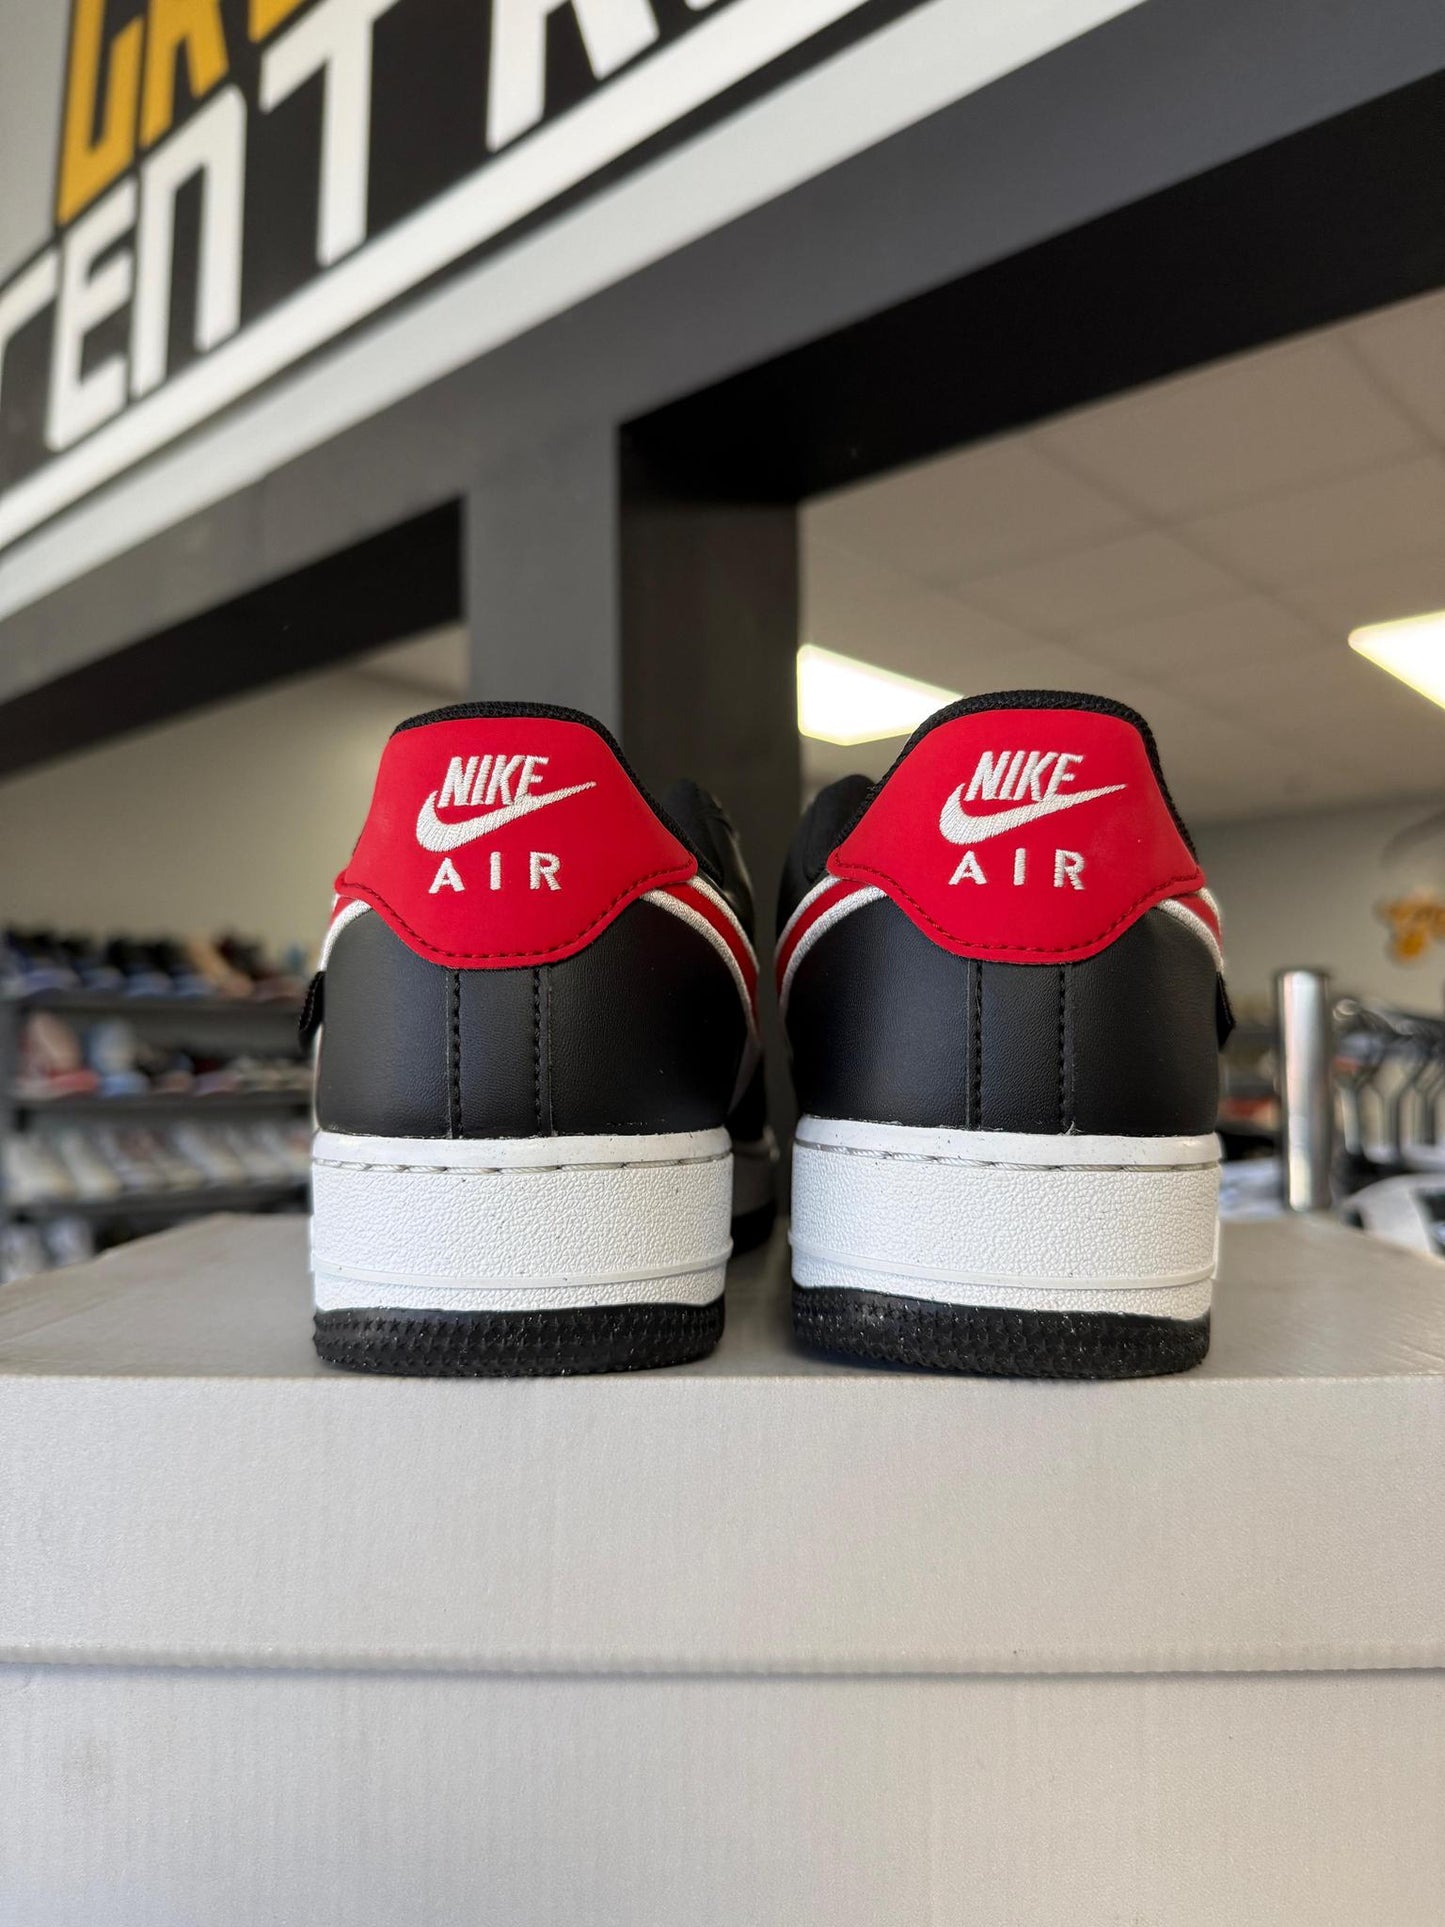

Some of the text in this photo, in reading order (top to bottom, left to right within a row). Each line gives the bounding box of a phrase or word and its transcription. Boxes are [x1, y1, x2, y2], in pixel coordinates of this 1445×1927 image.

[437, 754, 549, 808] NIKE
[964, 750, 1084, 802] NIKE
[428, 851, 562, 894] AIR
[948, 848, 1085, 890] AIR
